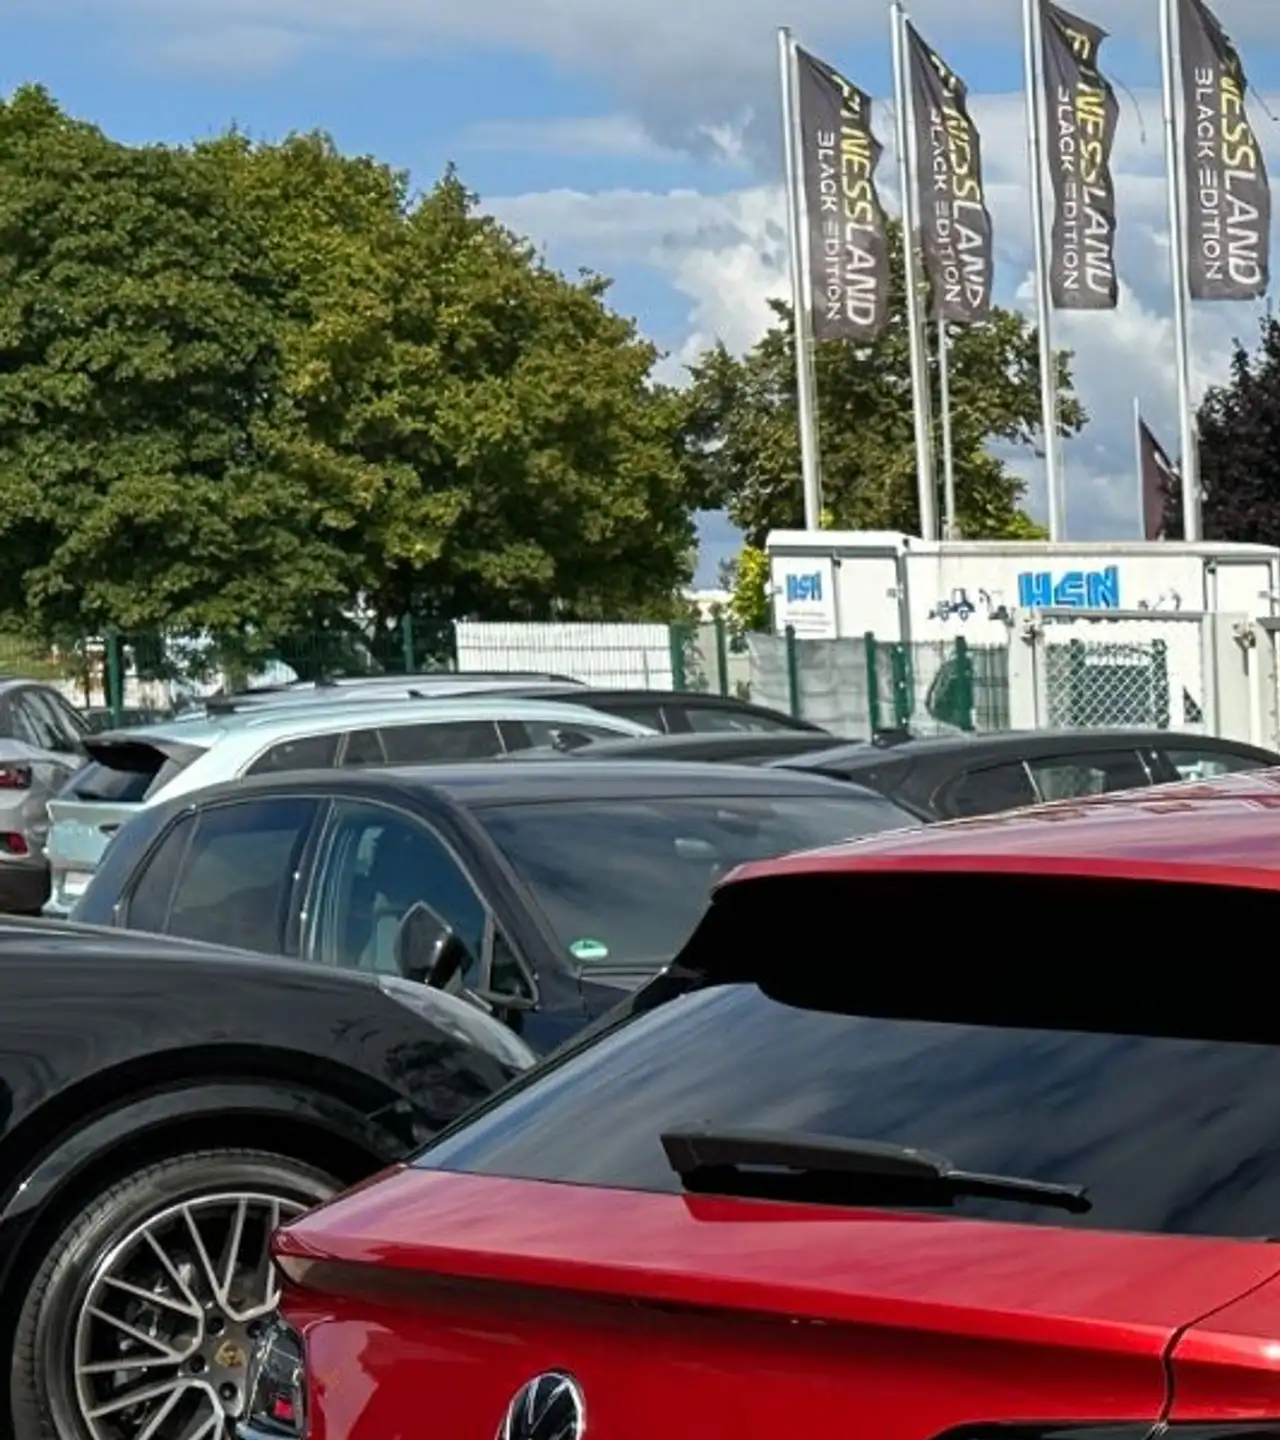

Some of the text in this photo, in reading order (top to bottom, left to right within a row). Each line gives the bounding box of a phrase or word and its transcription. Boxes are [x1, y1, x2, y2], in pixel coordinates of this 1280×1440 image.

[817, 130, 841, 320] BLACK EDITION
[1062, 177, 1080, 291] EDITION
[1195, 67, 1223, 281] BLACK EDITION
[934, 199, 961, 302] EDITION
